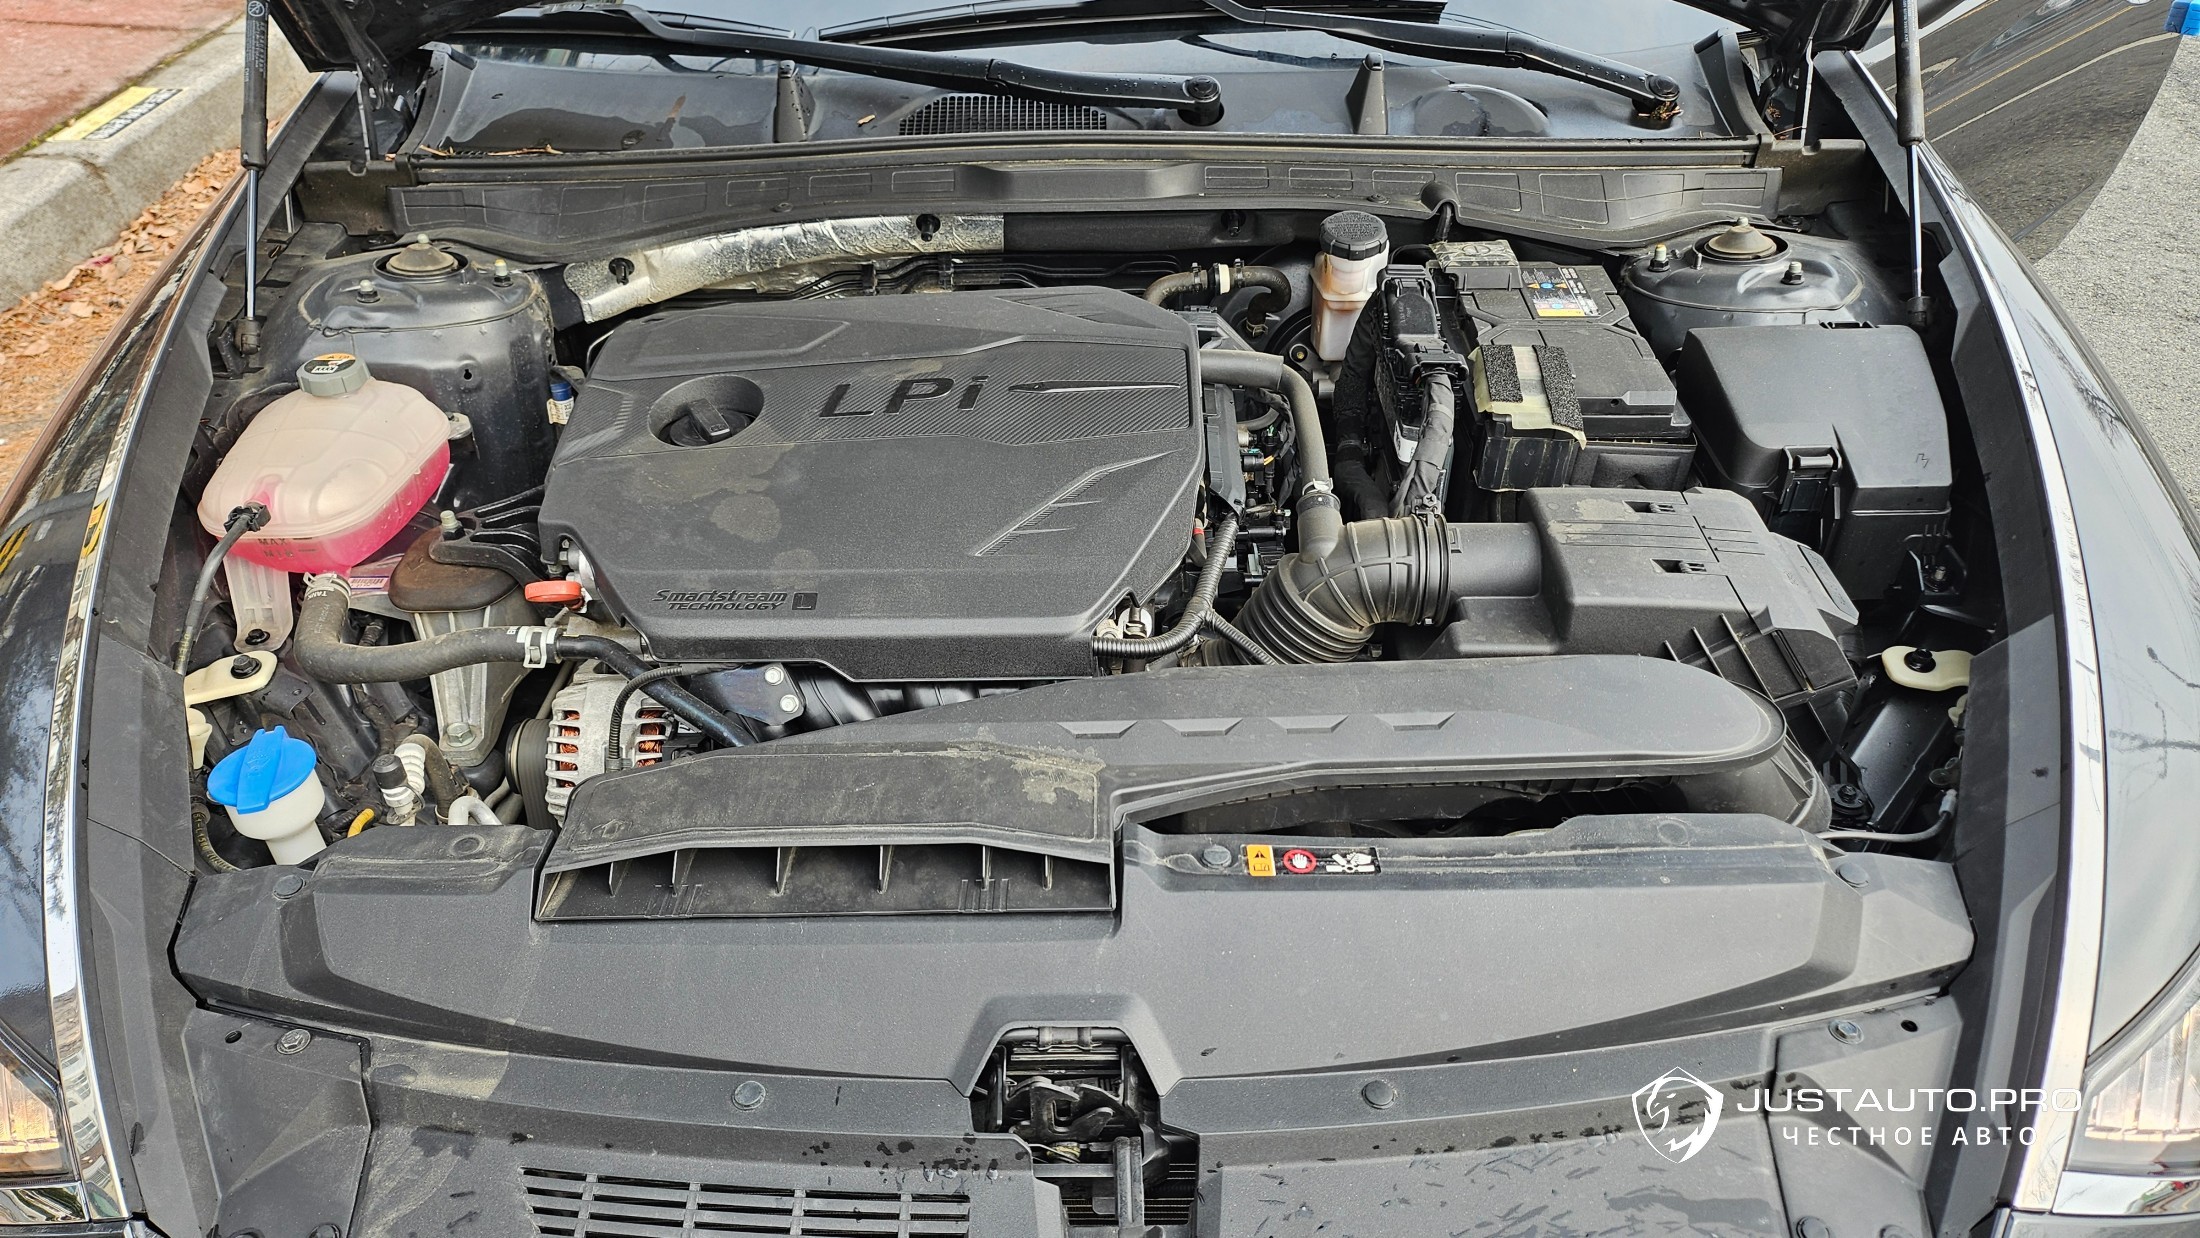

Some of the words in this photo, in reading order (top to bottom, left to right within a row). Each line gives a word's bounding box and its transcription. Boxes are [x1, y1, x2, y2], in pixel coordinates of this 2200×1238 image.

[819, 375, 990, 418] LPi
[258, 538, 287, 546] MAX
[651, 589, 788, 602] Smartstream
[667, 602, 785, 611] TECHNOLOGY
